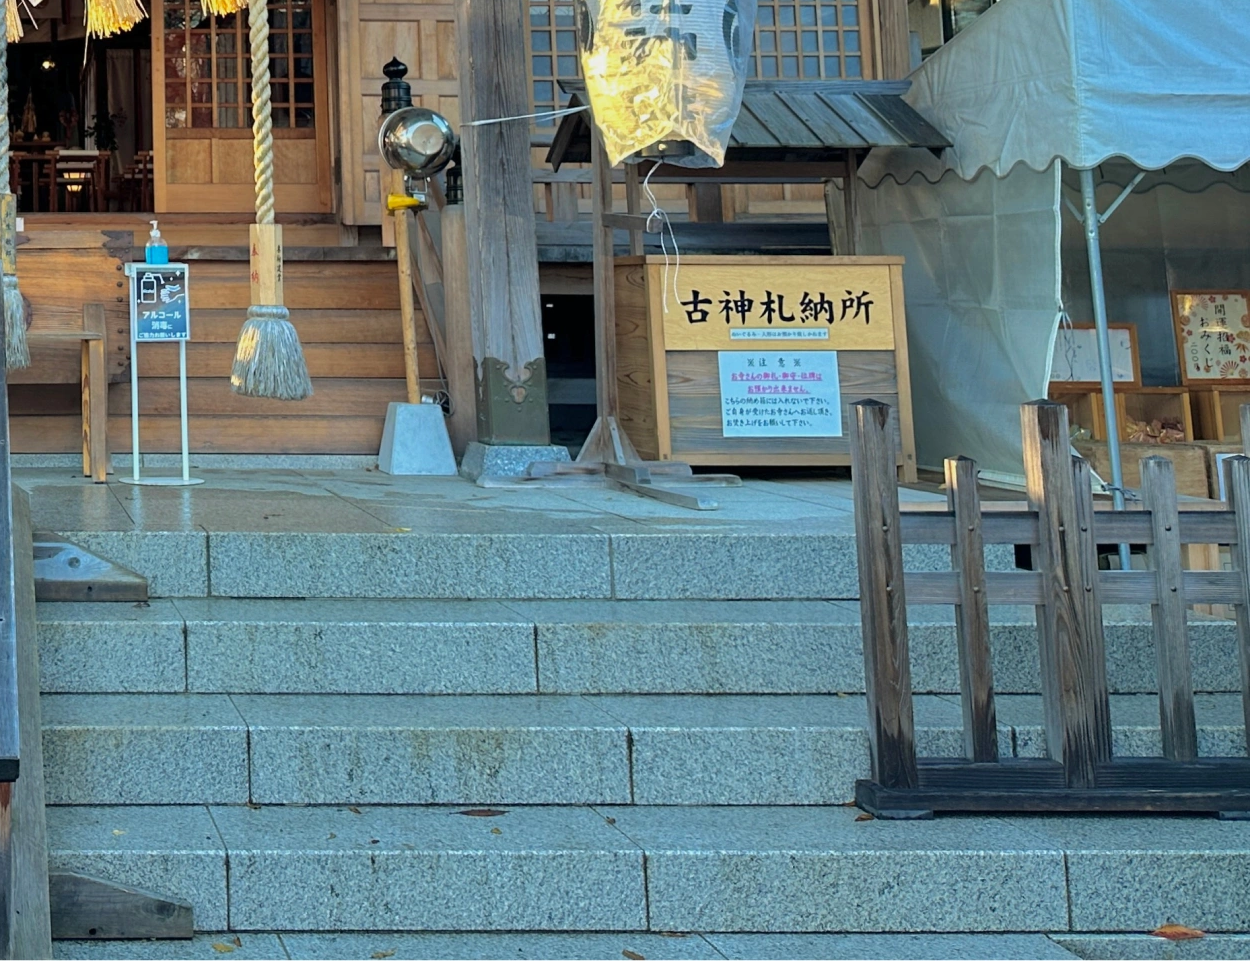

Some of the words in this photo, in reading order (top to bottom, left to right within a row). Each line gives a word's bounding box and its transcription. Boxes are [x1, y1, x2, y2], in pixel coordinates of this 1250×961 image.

[142, 311, 181, 320] アルコール
[152, 321, 173, 330] 消毒に
[681, 289, 874, 326] 古神札納所
[1200, 317, 1213, 368] おみくじ
[1214, 305, 1232, 355] 開運招福
